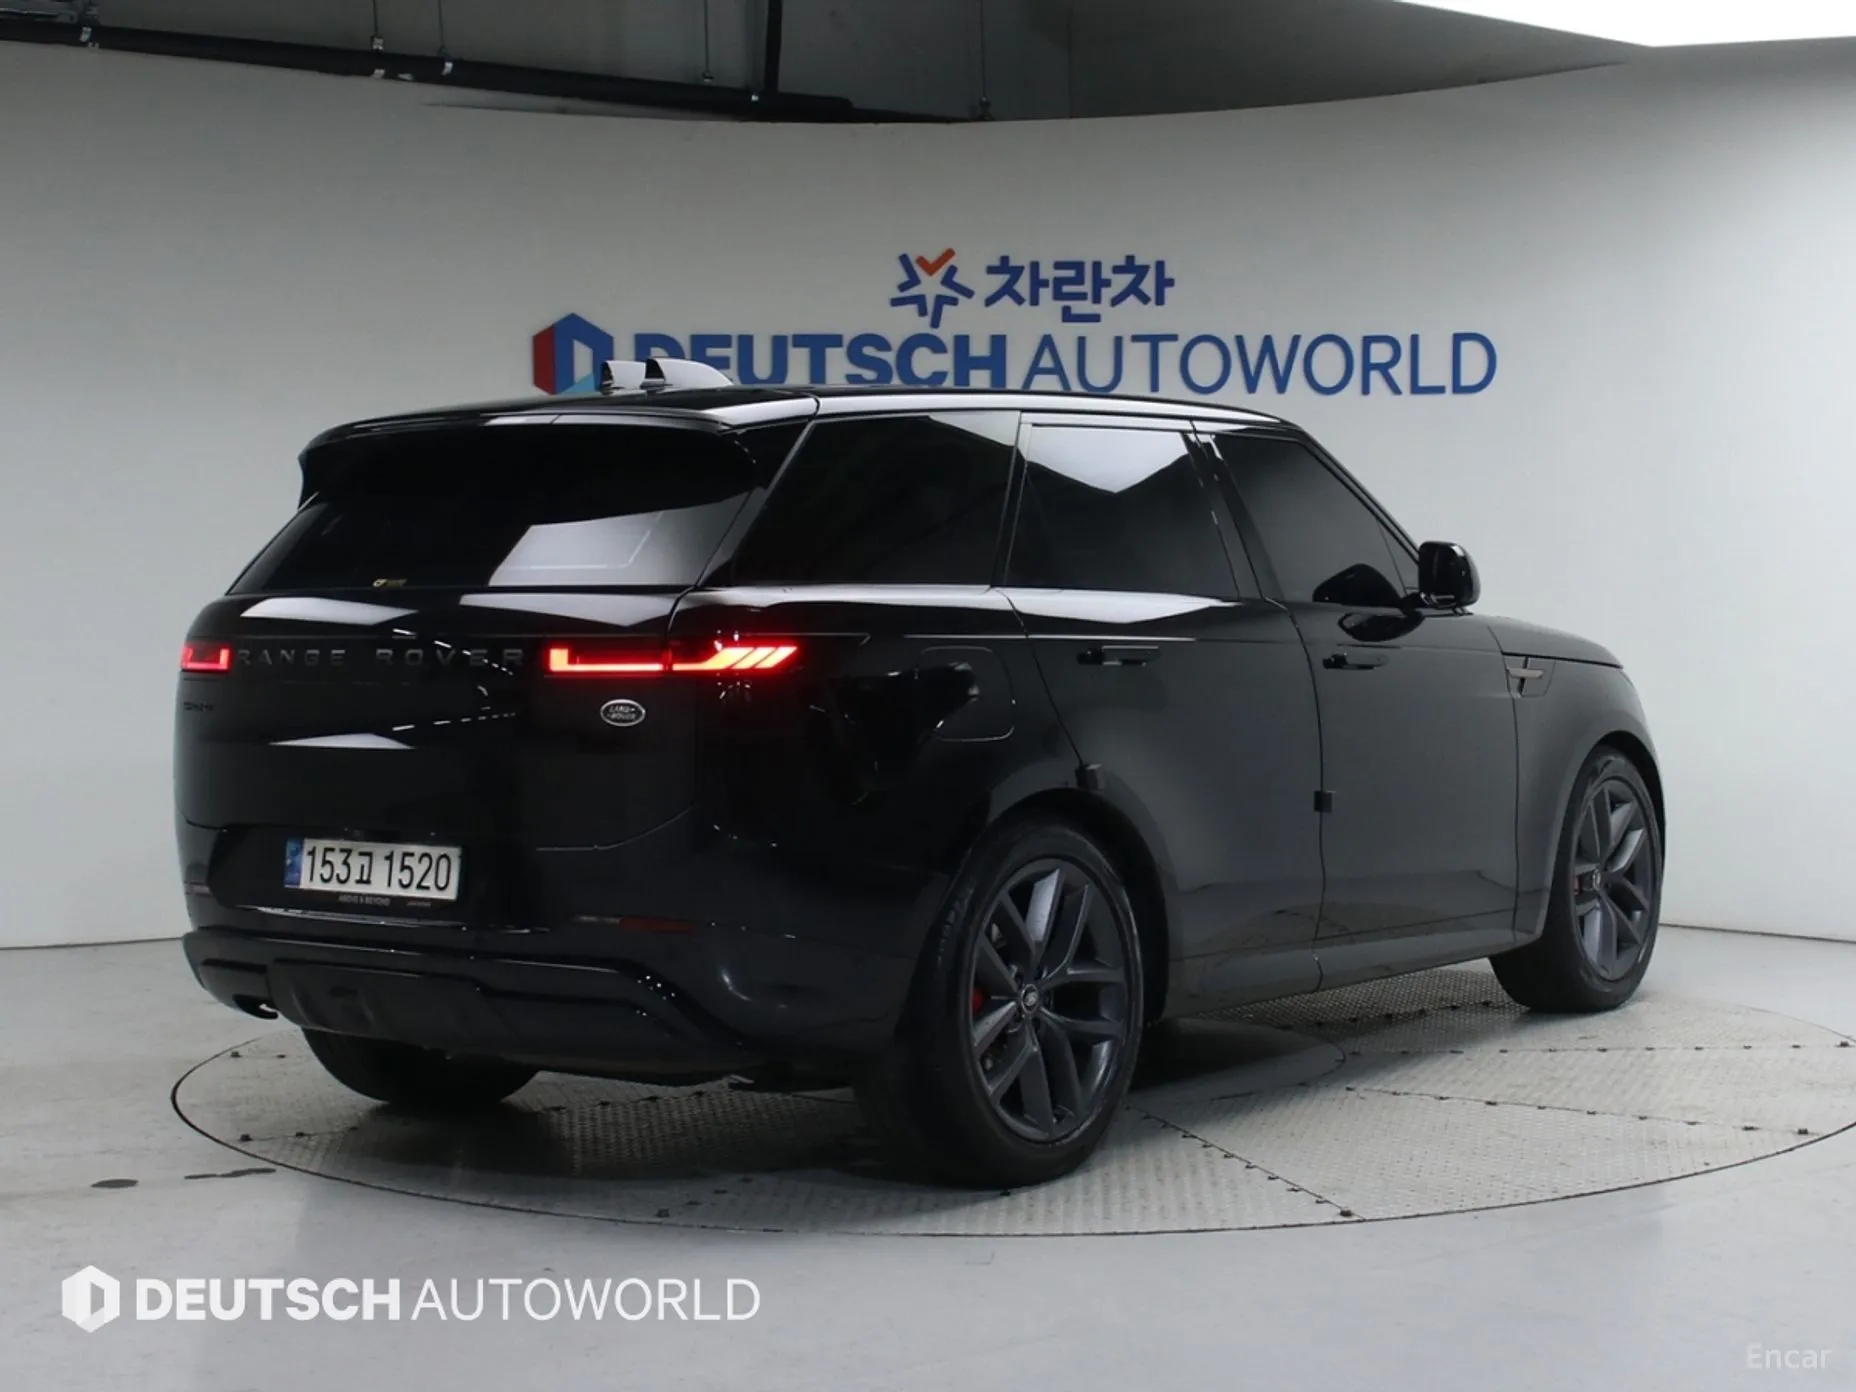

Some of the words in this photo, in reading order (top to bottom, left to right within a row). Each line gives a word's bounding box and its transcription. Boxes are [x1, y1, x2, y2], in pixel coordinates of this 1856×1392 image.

[984, 255, 1175, 323] 차란차
[1021, 332, 1497, 395] AUTOWORLD
[237, 649, 346, 665] RANGE
[375, 648, 524, 665] ROVER
[384, 850, 452, 891] 1520
